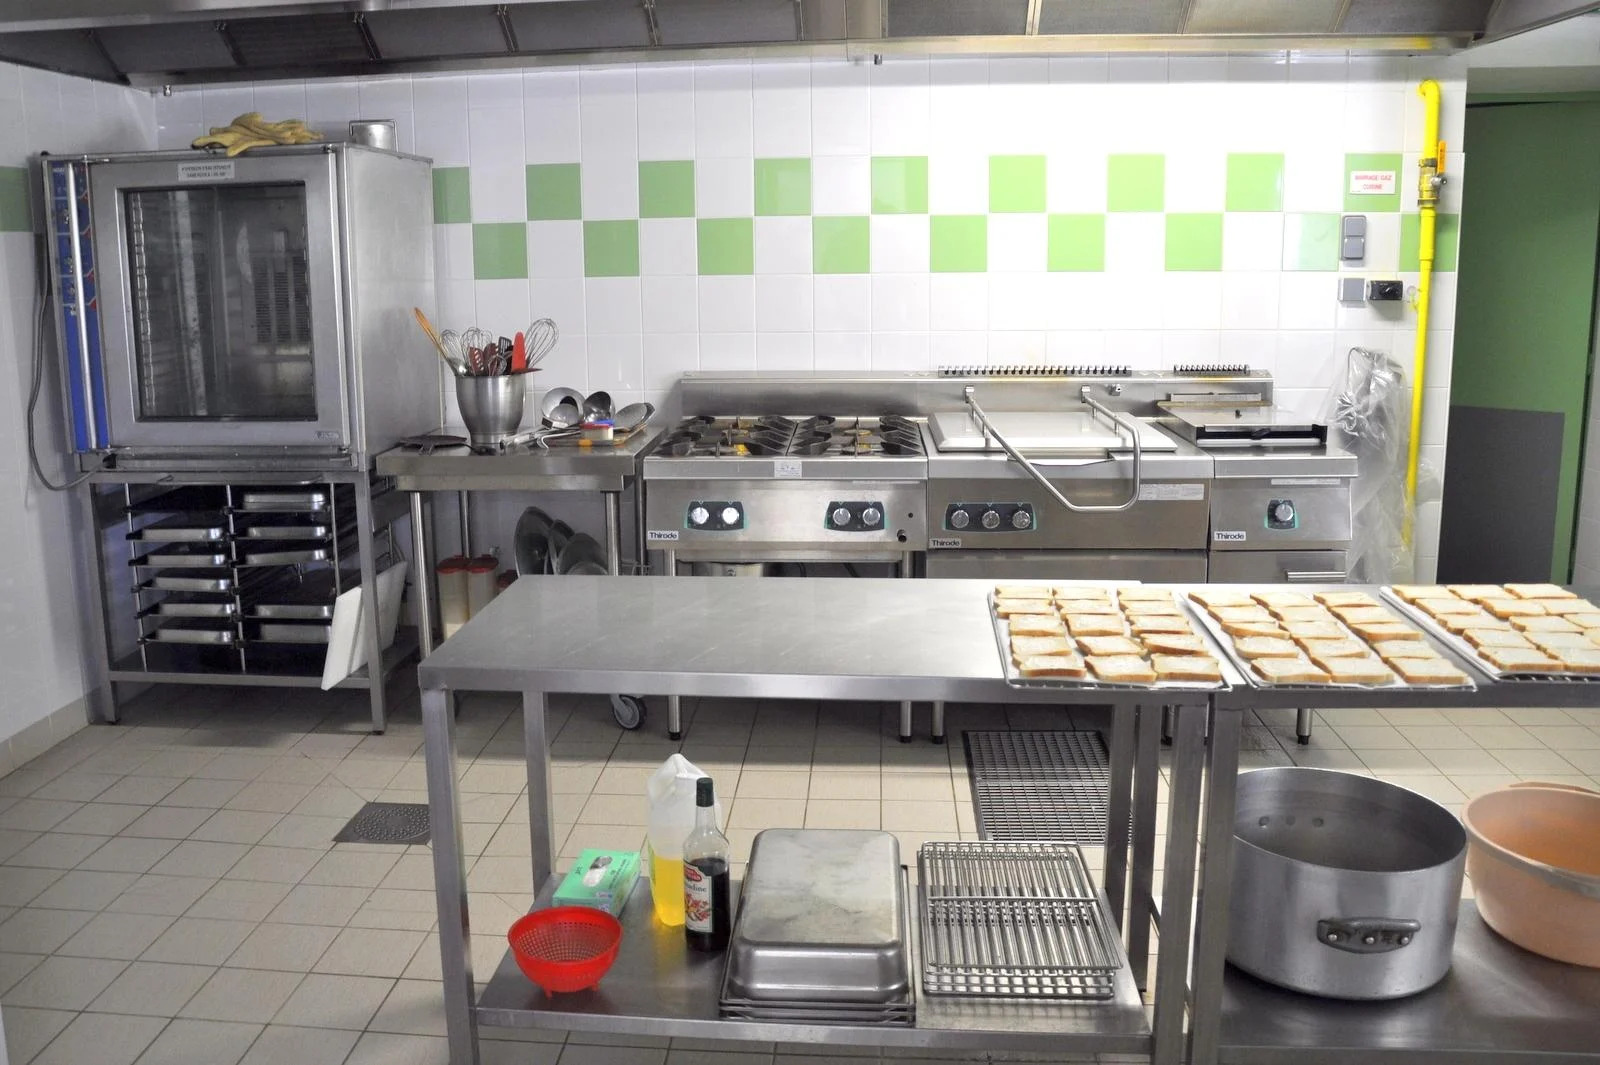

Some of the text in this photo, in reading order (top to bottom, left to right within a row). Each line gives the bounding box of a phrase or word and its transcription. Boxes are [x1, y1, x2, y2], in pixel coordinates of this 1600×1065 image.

[649, 531, 677, 539] Thirode
[1216, 532, 1244, 540] Thirode
[931, 539, 960, 547] Thirode
